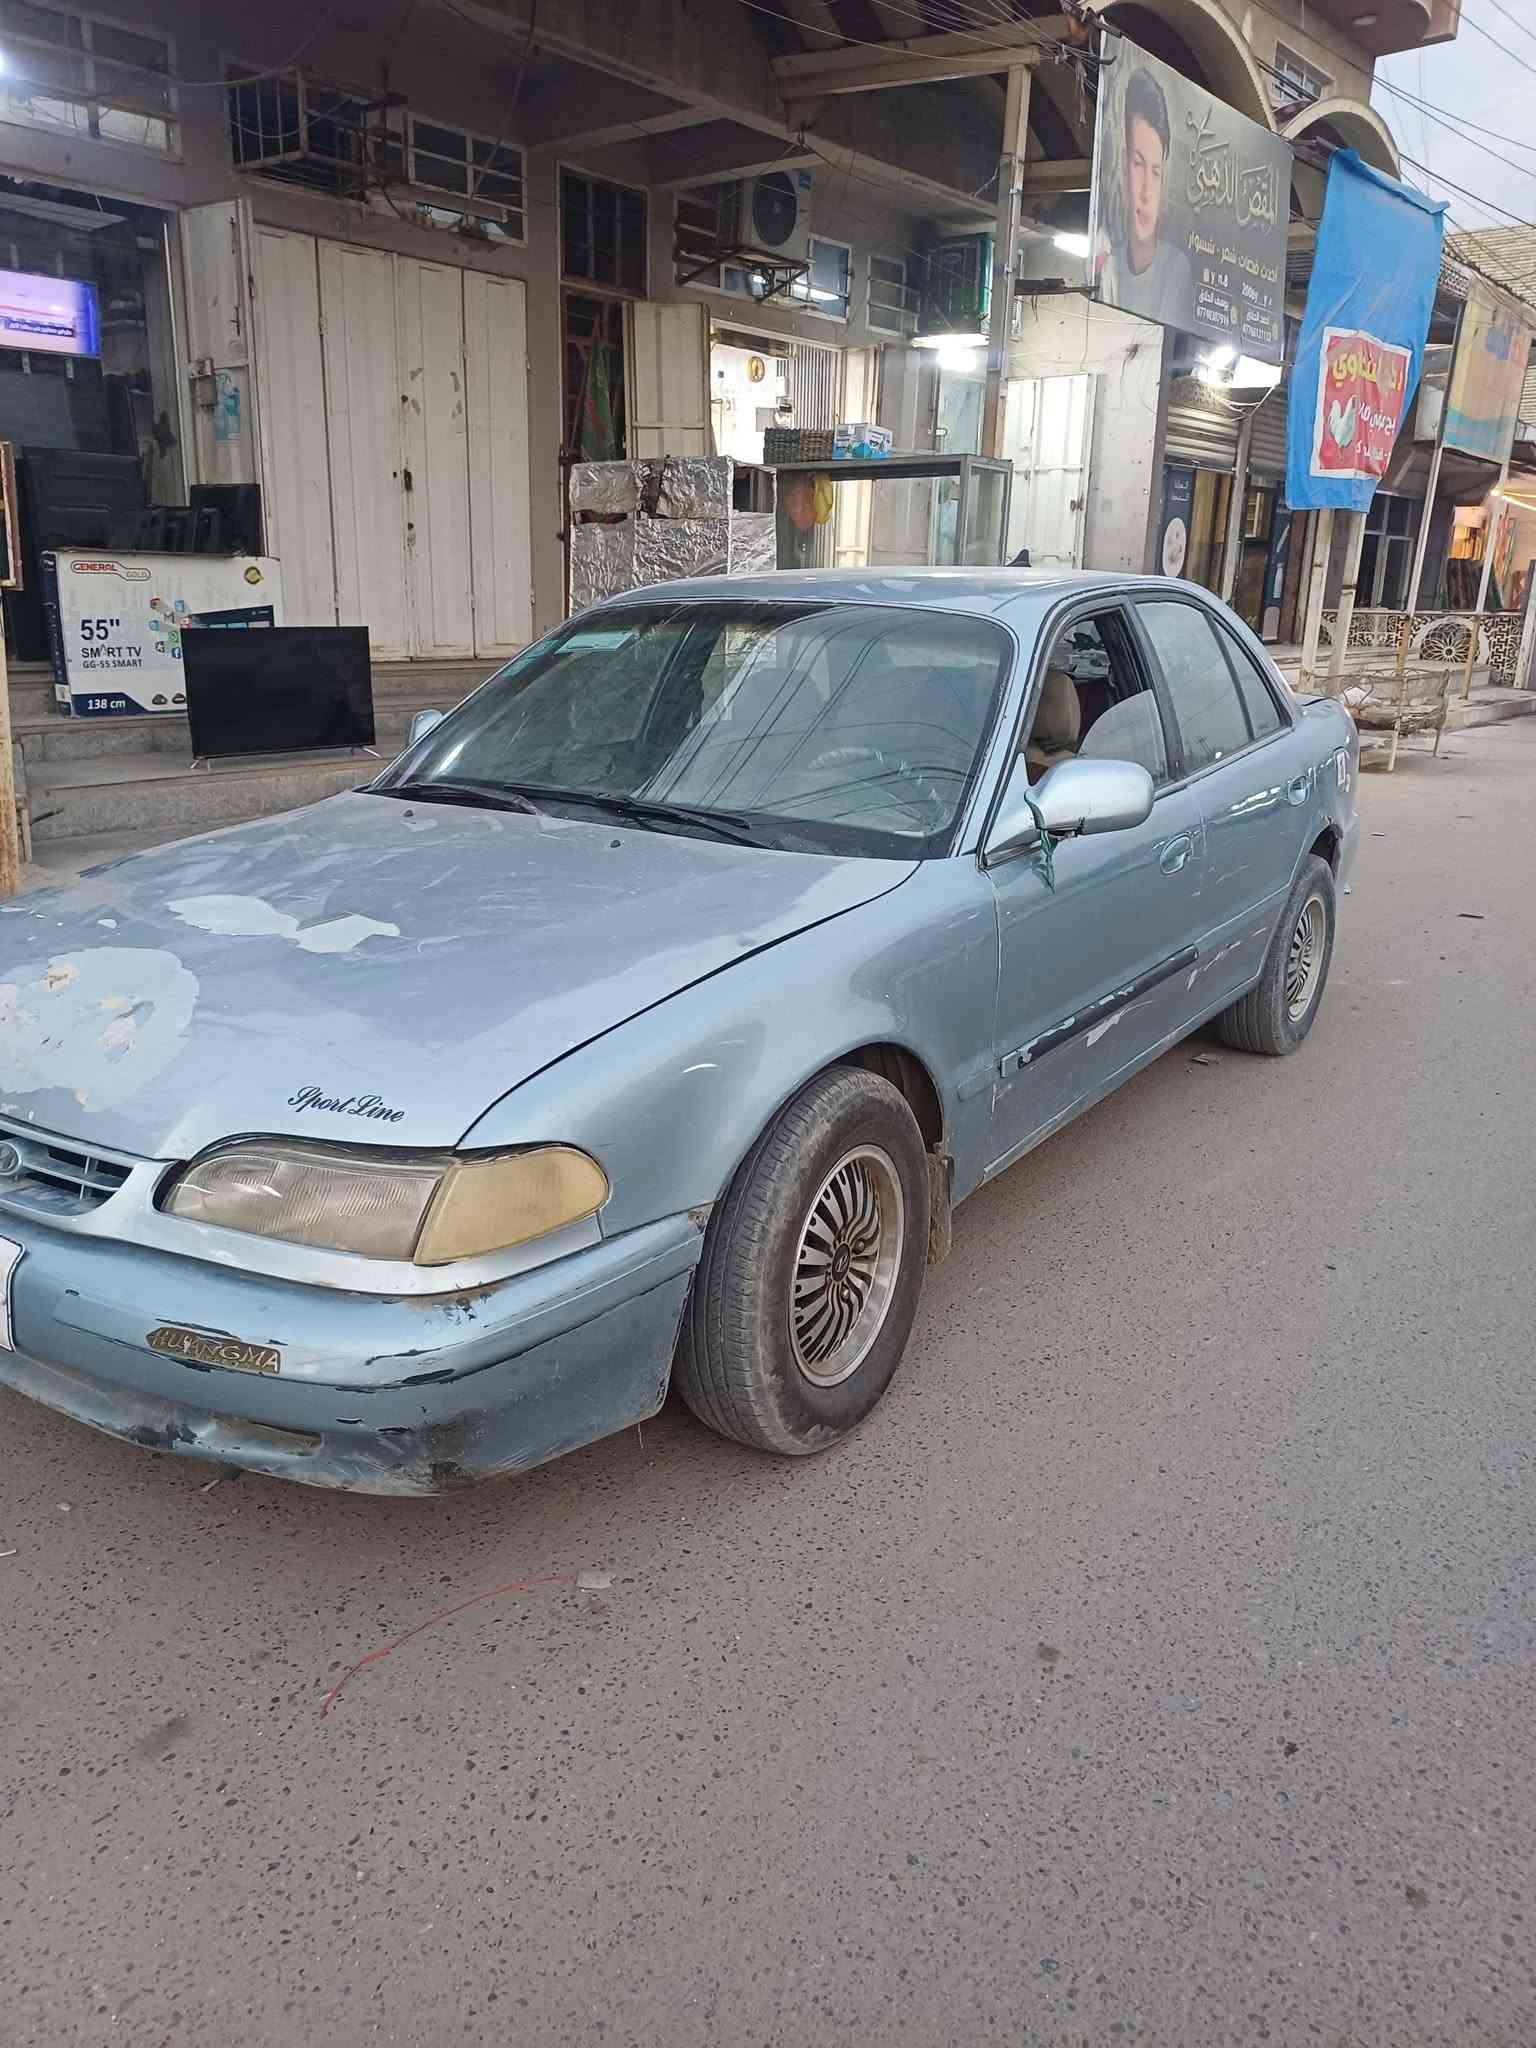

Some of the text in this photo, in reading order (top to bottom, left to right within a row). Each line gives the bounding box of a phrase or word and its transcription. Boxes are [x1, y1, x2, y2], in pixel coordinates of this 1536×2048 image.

[73, 563, 118, 572] GENERAL
[80, 618, 120, 641] 55"
[126, 645, 142, 657] TV
[82, 658, 143, 669] GG-55 SMART
[87, 698, 126, 710] 138 cm
[287, 1085, 405, 1122] Sport Line
